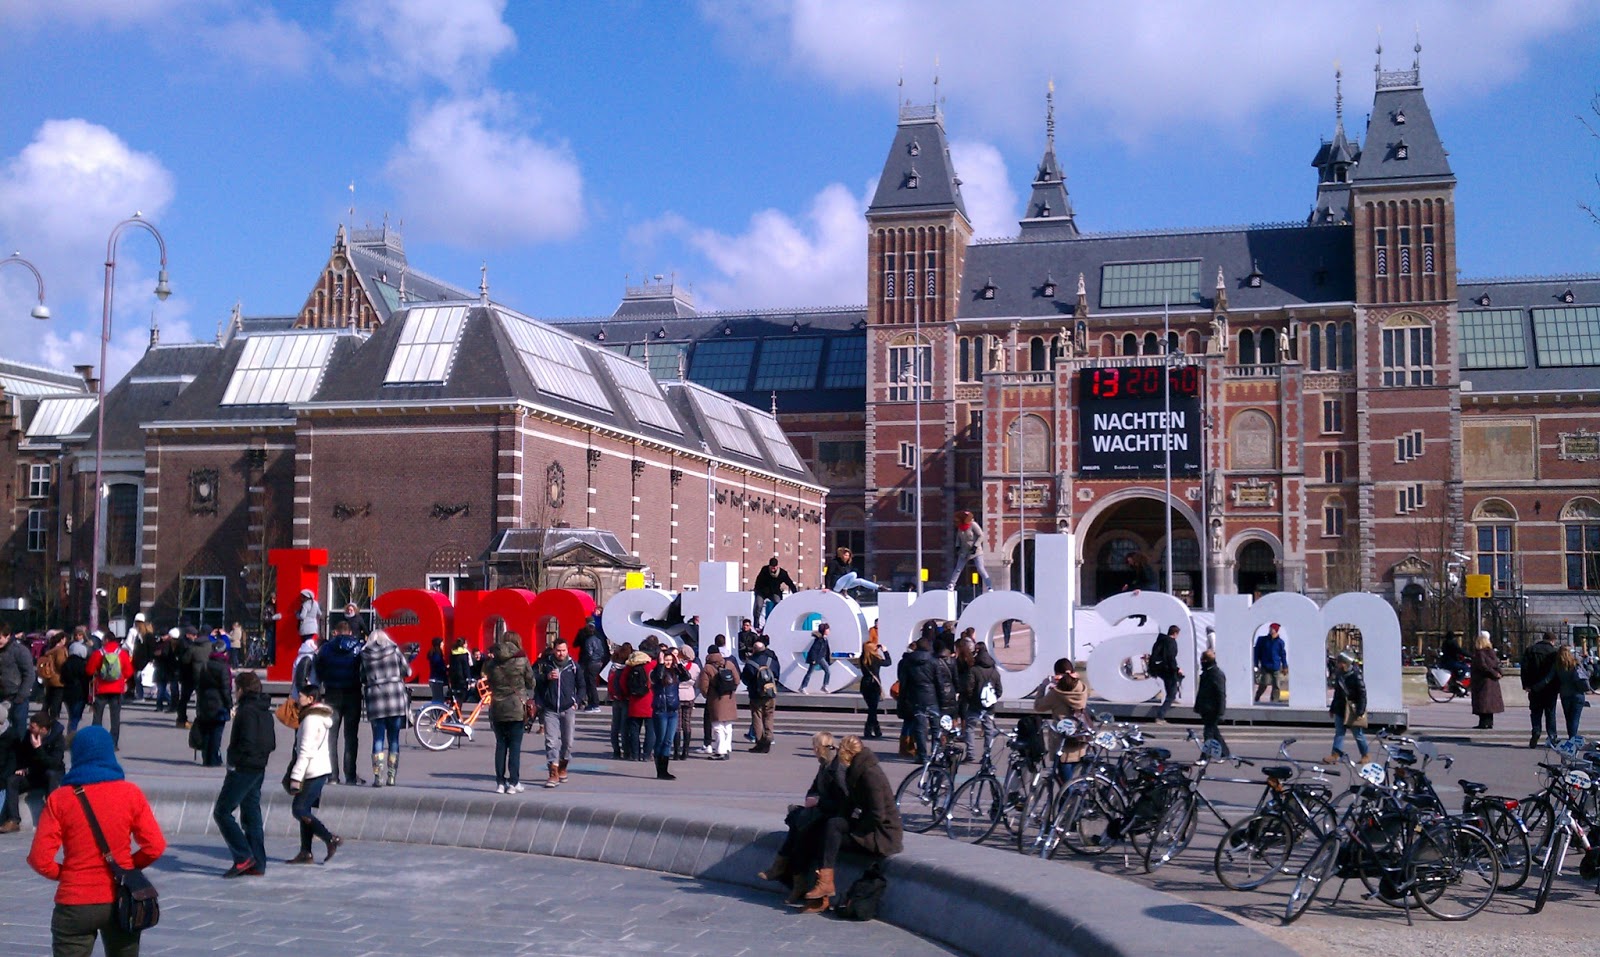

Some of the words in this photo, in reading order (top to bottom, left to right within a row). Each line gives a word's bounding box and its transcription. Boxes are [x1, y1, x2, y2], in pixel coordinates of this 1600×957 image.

[1093, 368, 1119, 397] 13
[1126, 368, 1158, 394] 20
[1094, 411, 1185, 430] NACHTEN
[1092, 433, 1188, 453] WACHTEN
